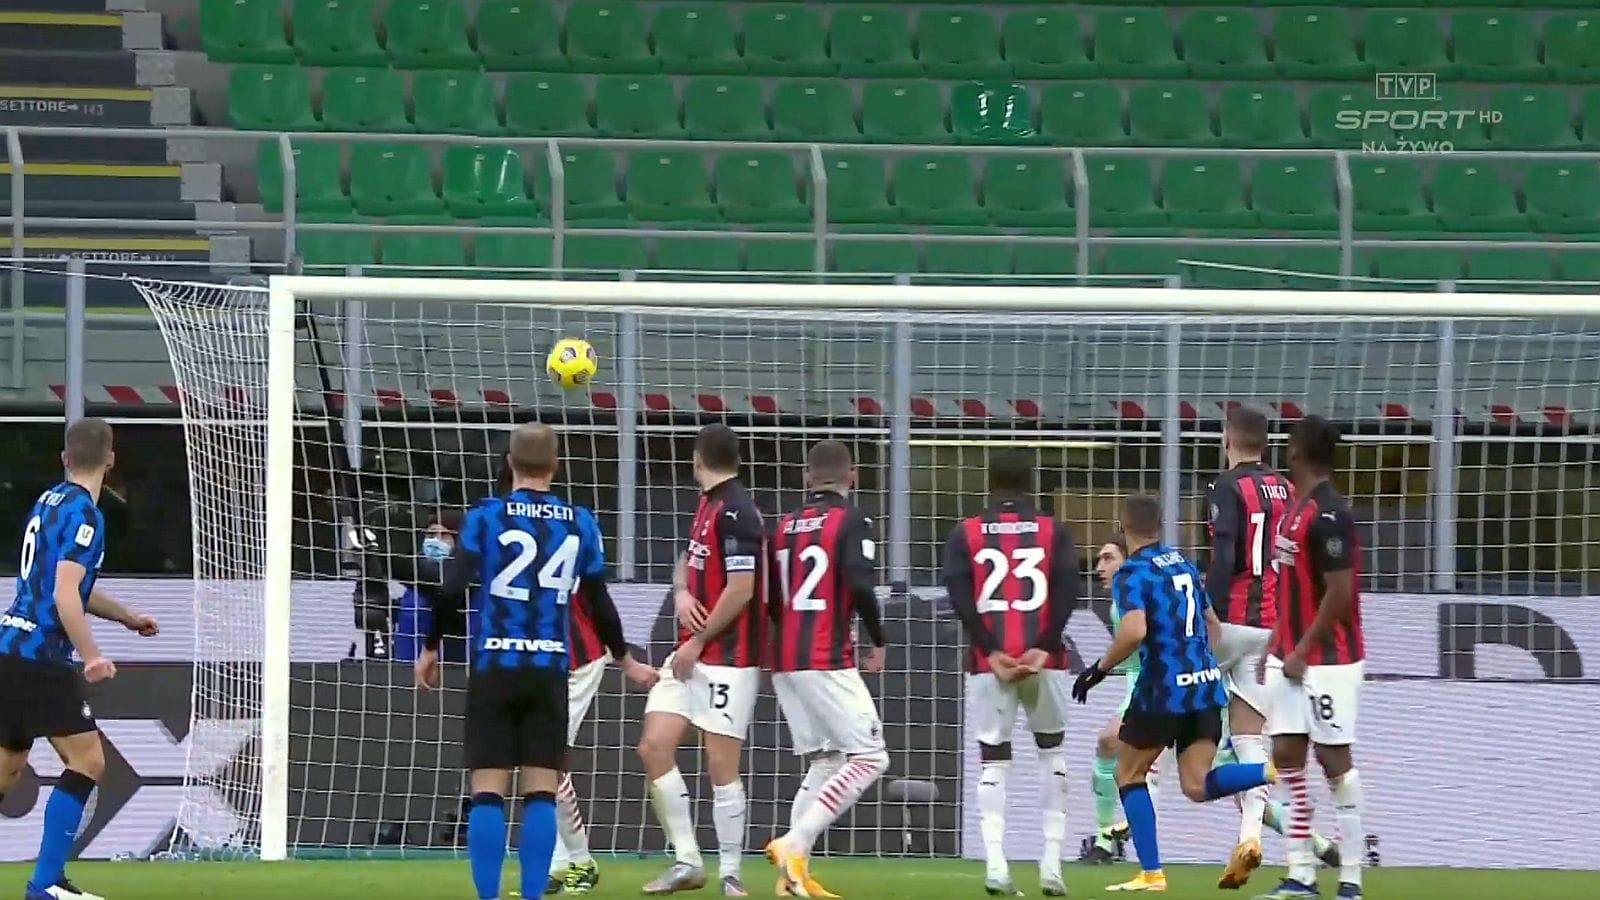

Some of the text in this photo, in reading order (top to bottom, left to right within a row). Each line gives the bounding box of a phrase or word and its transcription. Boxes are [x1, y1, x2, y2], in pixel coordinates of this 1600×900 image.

[0, 99, 67, 113] SETTORE
[507, 501, 574, 521] ERIKSEN
[21, 514, 41, 582] 6
[490, 529, 580, 605] 24
[776, 544, 830, 611] 12
[974, 547, 1049, 614] 23
[1172, 573, 1196, 637] 7
[708, 682, 730, 710] 13
[1309, 693, 1334, 722] 18
